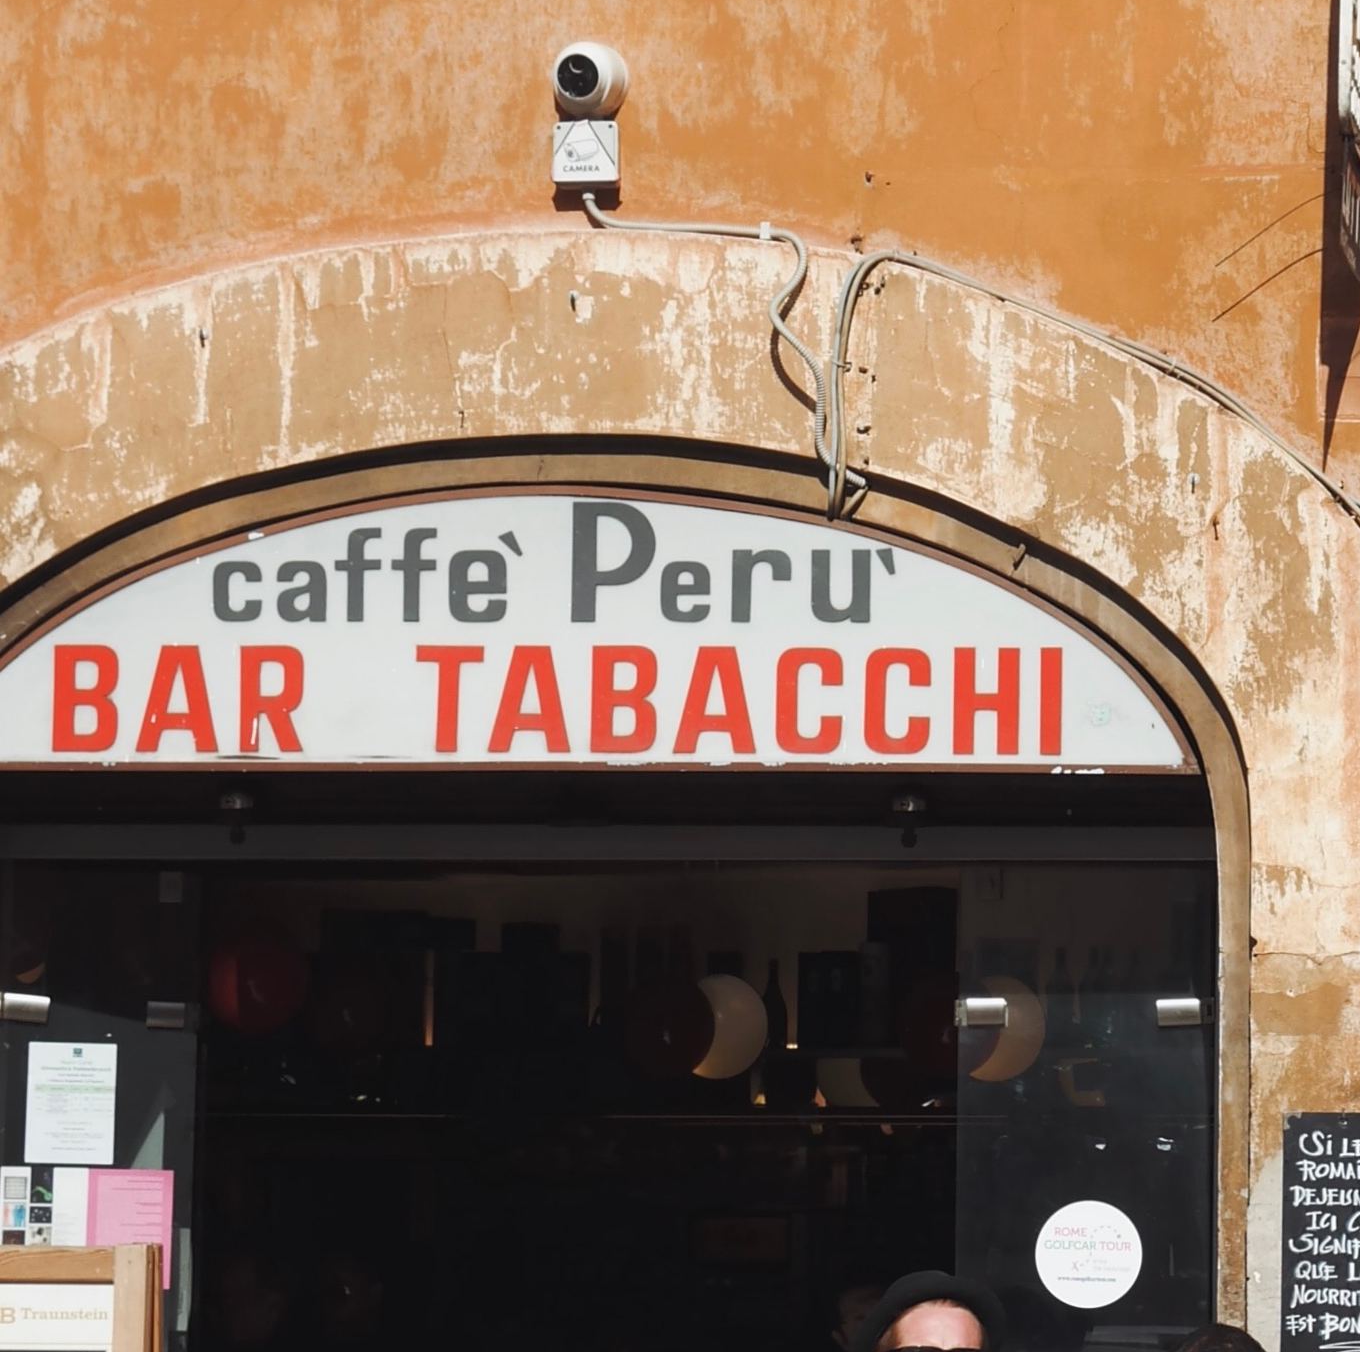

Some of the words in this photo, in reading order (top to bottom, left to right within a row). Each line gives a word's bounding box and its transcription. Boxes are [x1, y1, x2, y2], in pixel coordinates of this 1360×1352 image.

[562, 165, 600, 173] CAMERA
[50, 644, 305, 754] BAR
[415, 644, 1063, 757] TABACCHI
[1305, 1211, 1337, 1231] ICI
[1054, 1226, 1088, 1237] ROME
[1044, 1239, 1097, 1250] GOLFCAR
[1099, 1241, 1132, 1252] TOUR
[1295, 1260, 1338, 1280] QUE
[20, 1307, 108, 1320] Traunstein
